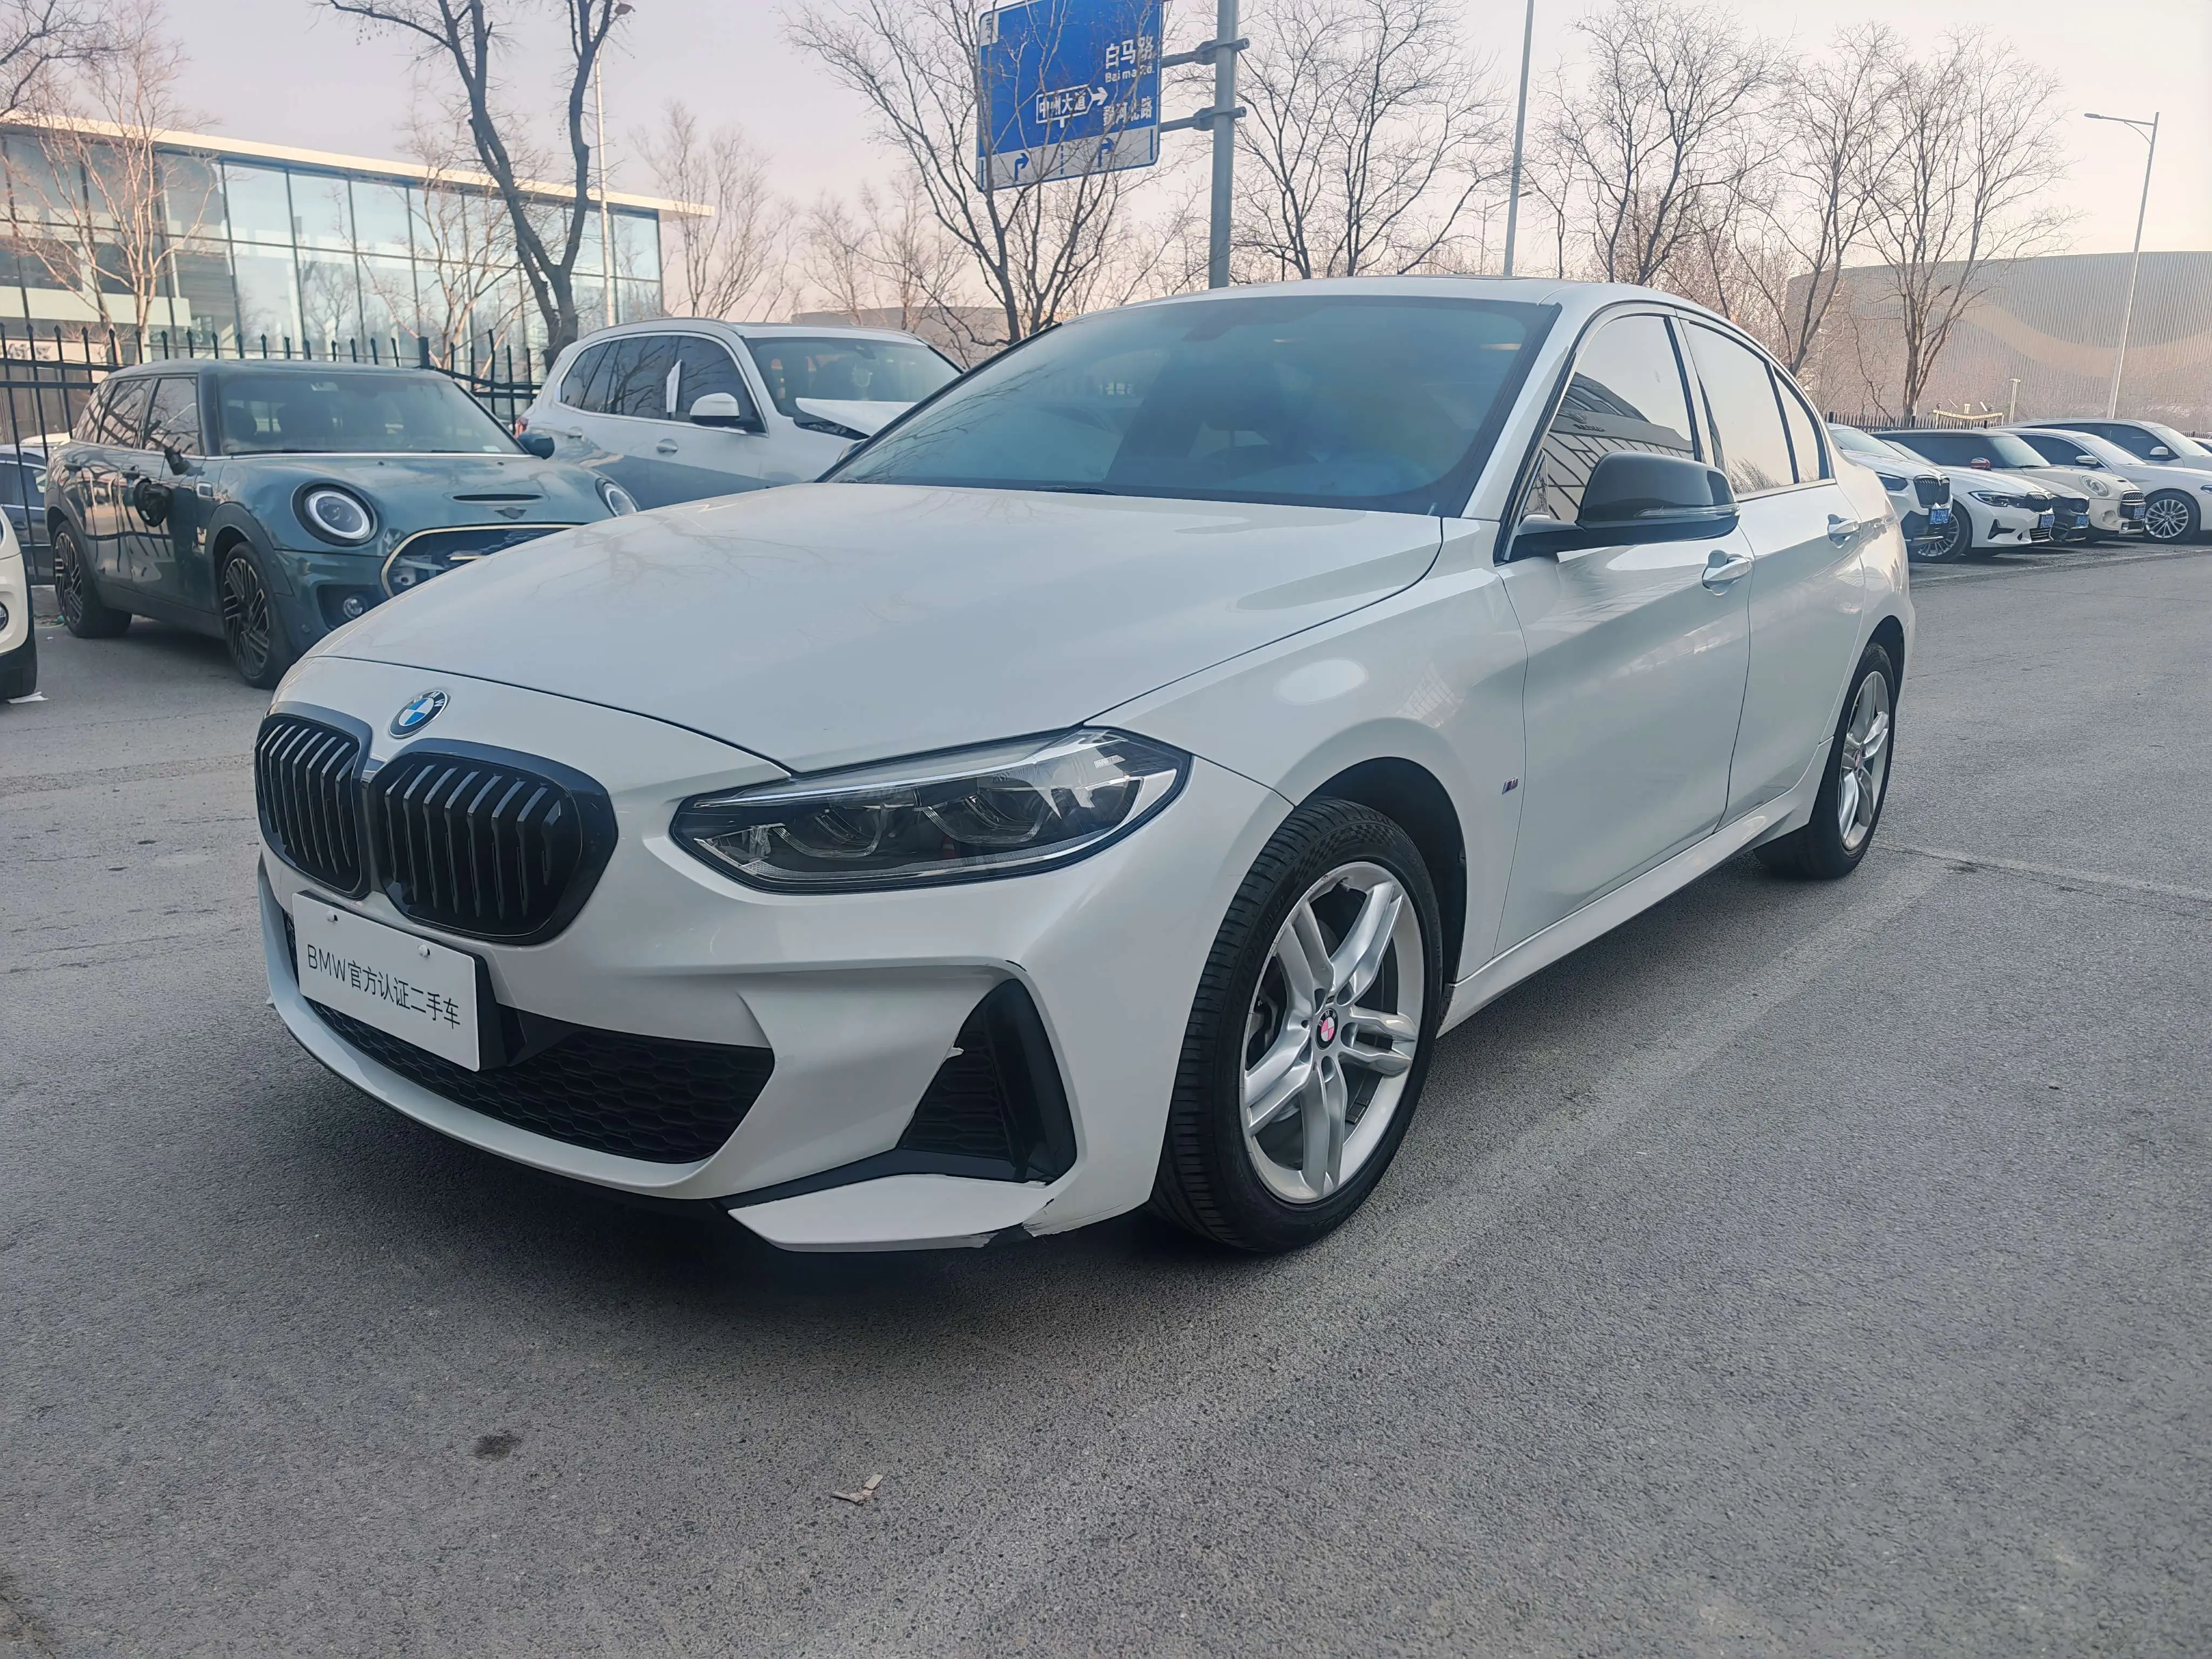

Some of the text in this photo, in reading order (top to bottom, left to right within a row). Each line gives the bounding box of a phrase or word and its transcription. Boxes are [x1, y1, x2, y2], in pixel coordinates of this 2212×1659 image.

[1105, 35, 1154, 69] 白马路
[1039, 91, 1086, 118] 中州大道
[307, 943, 461, 1029] BMW官方认证二手车
[1318, 1010, 1337, 1027] BMW
